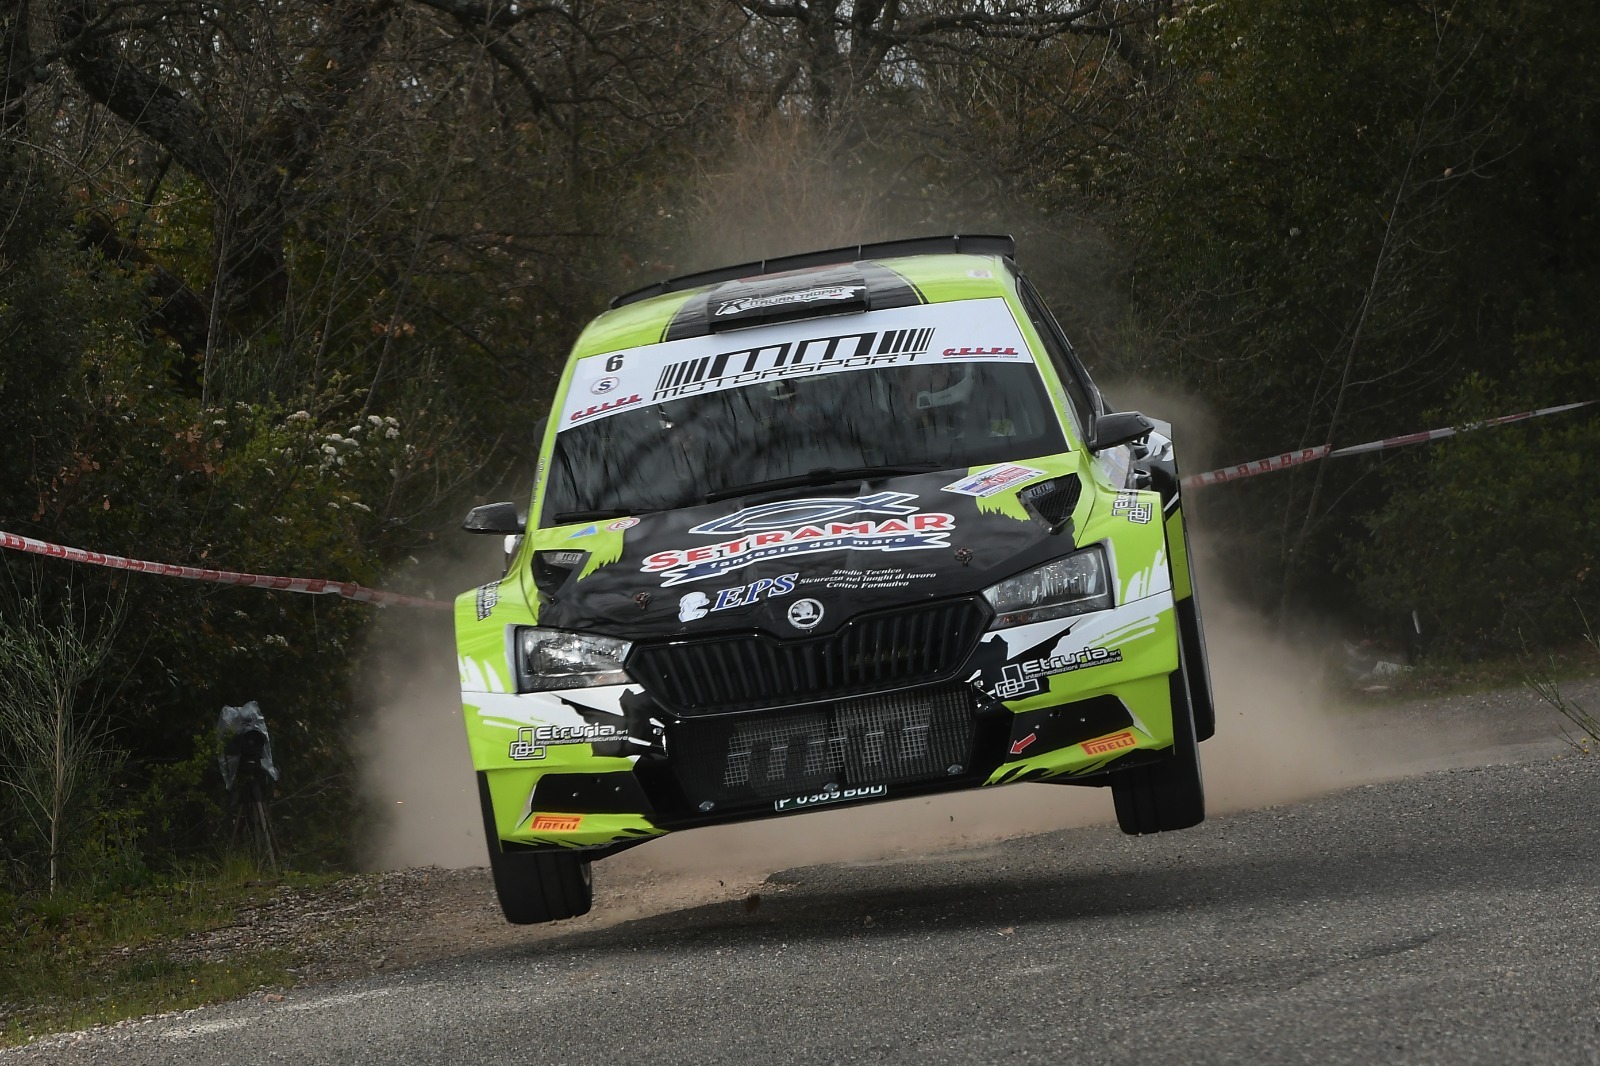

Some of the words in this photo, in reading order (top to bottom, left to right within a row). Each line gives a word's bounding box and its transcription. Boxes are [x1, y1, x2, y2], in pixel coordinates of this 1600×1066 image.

[750, 295, 795, 306] ITALIAN
[799, 287, 845, 300] TROPHY
[605, 354, 624, 372] 6
[652, 351, 927, 401] MOTORSPORT
[646, 514, 952, 570] SETRAMAR
[710, 546, 799, 568] fantasie
[809, 539, 842, 548] del
[852, 537, 906, 546] mare
[799, 576, 843, 585] Sicurezza
[832, 568, 863, 576] Studio
[711, 573, 799, 612] EPS
[861, 581, 910, 589] Formativo
[1022, 646, 1108, 673] Etruria
[1025, 664, 1079, 680] intermediazioni
[1080, 655, 1122, 669] assicurative
[536, 722, 615, 740] Etruria
[1081, 732, 1136, 755] PIRELLI
[531, 816, 581, 830] PIRELLI
